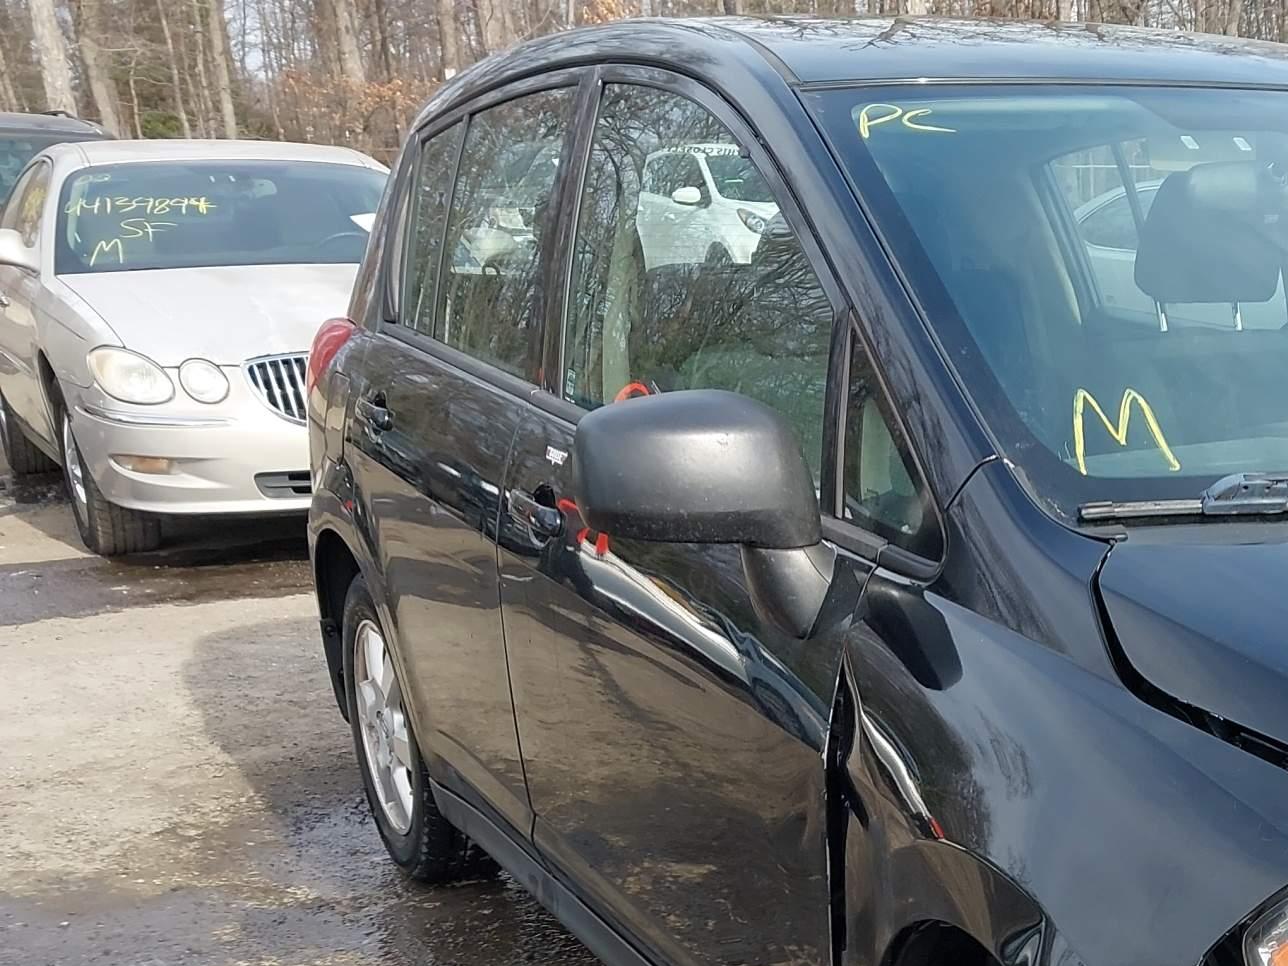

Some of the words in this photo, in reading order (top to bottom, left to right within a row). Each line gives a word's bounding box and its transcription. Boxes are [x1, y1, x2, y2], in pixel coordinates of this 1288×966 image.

[860, 103, 957, 138] PC
[90, 239, 124, 267] M
[1073, 388, 1181, 476] M
